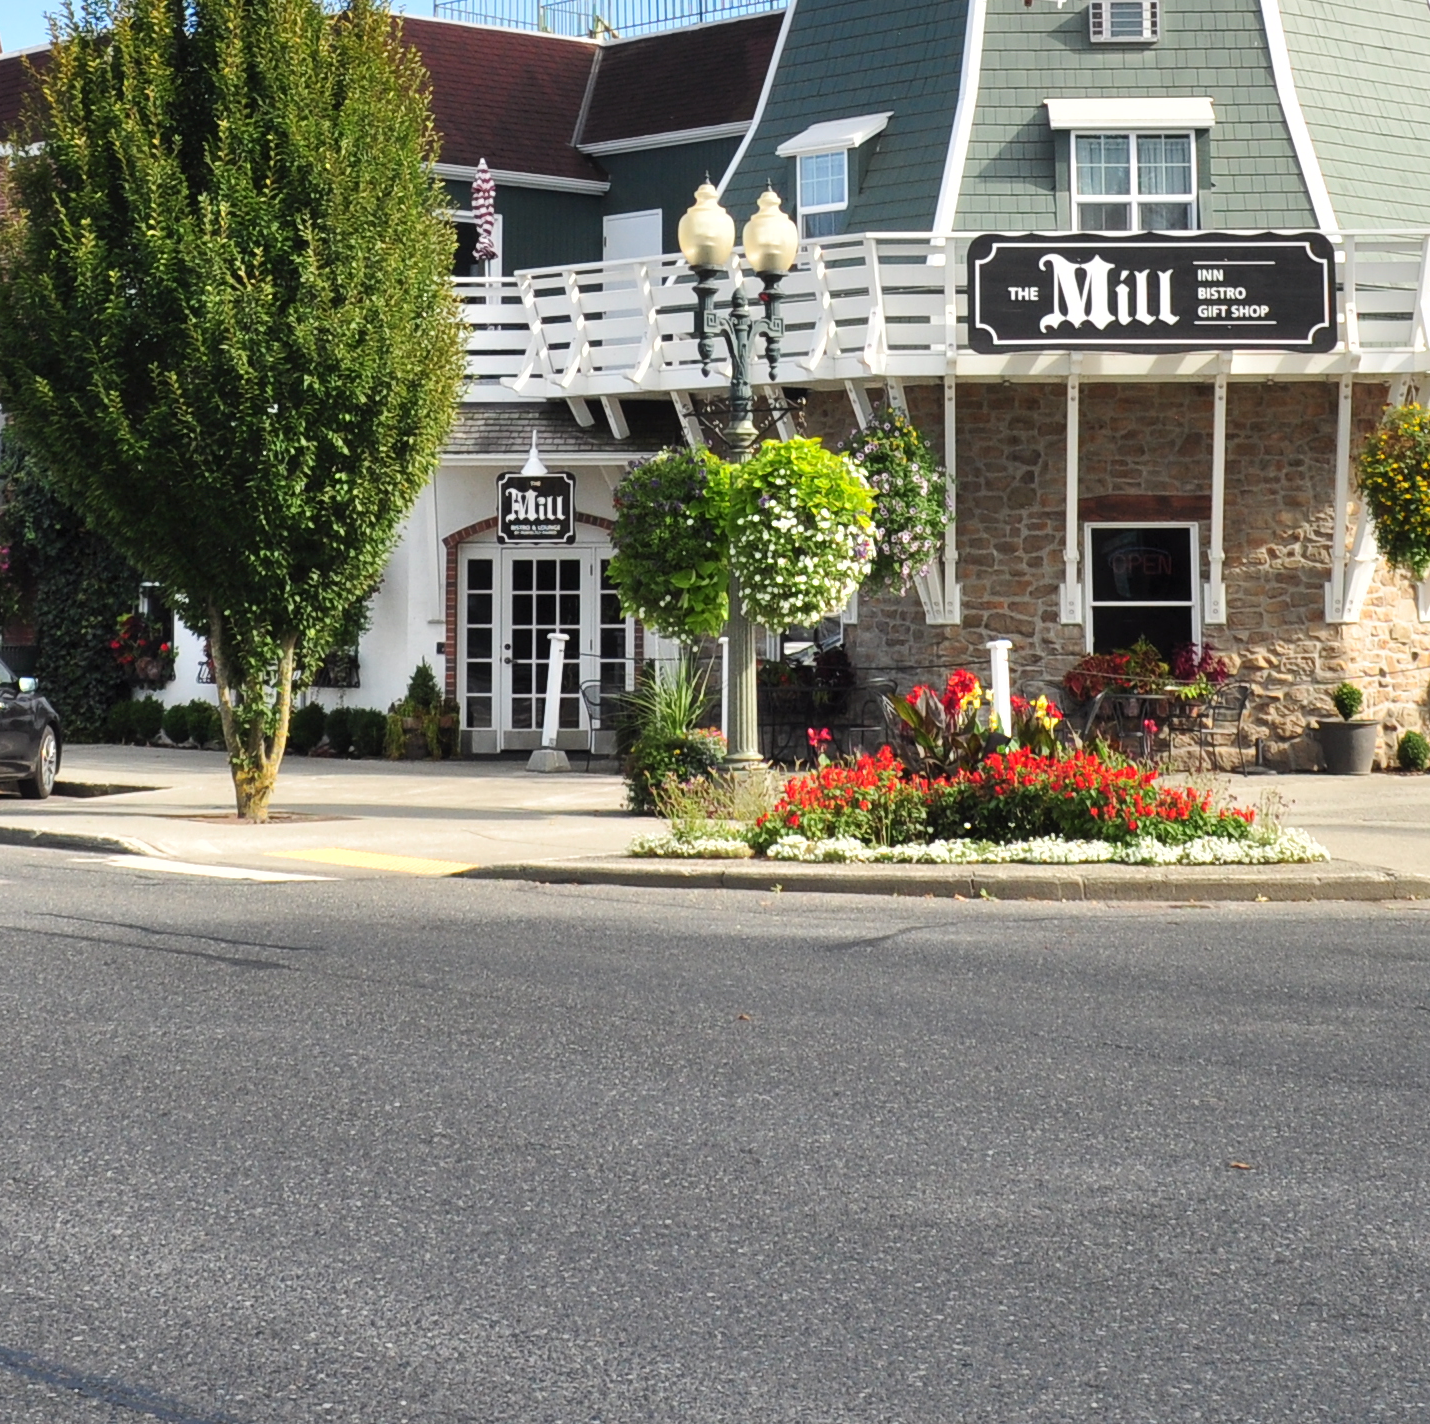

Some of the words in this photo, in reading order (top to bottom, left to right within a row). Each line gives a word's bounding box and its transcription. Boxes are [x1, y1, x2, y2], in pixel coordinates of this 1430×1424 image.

[1197, 269, 1224, 282] INN
[1008, 287, 1039, 301] THE
[1039, 253, 1180, 333] Mill
[1197, 287, 1247, 300] BISTRO
[1197, 305, 1228, 318] GIFT
[1231, 305, 1270, 318] SHOP
[505, 487, 566, 524] Mill
[1112, 554, 1172, 575] OPEN
